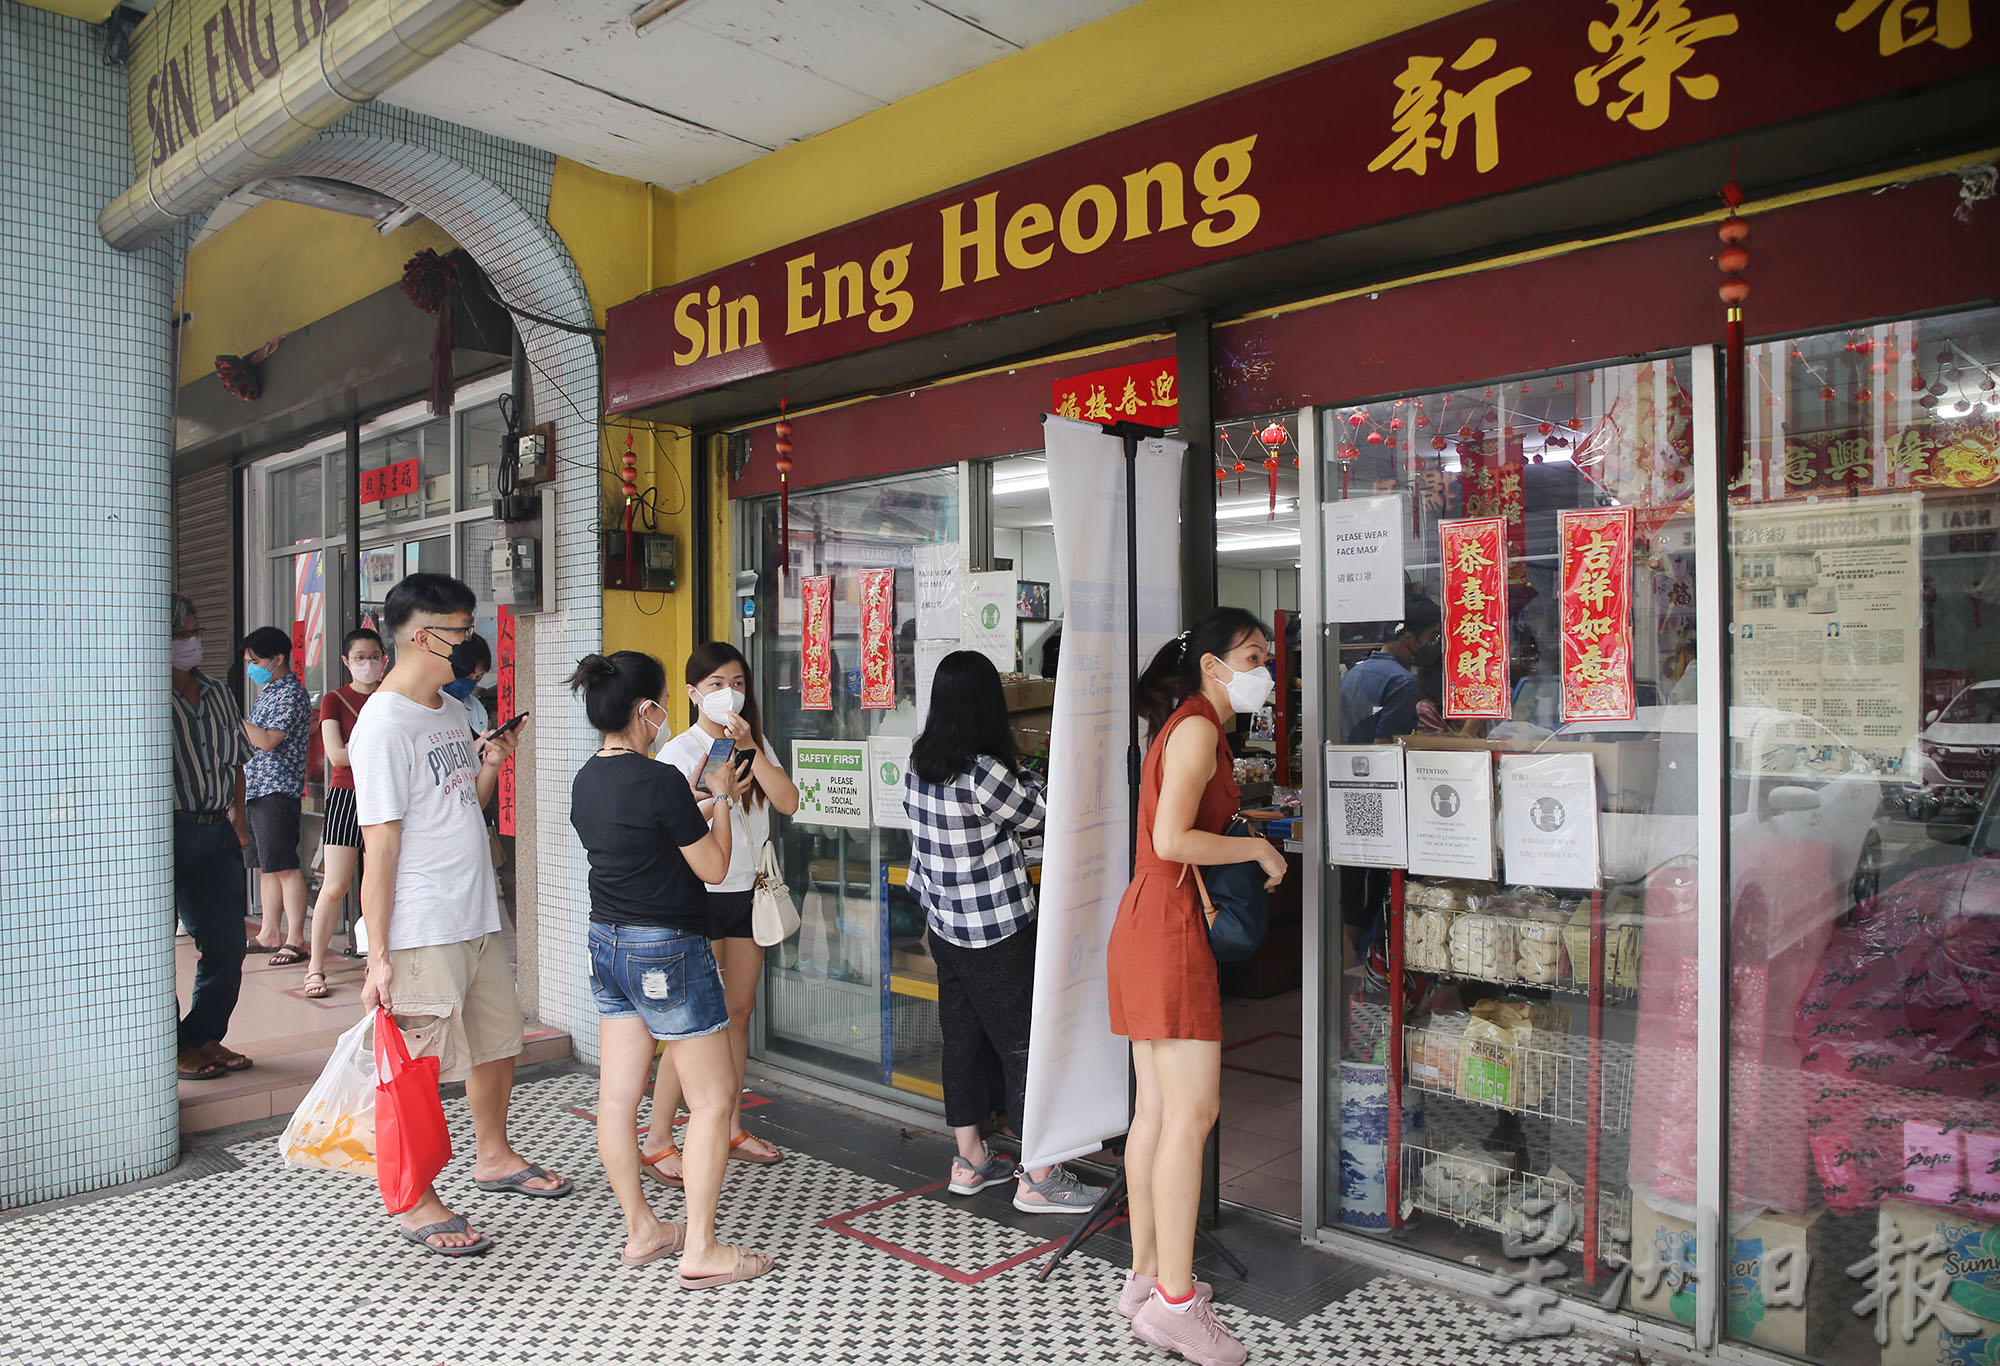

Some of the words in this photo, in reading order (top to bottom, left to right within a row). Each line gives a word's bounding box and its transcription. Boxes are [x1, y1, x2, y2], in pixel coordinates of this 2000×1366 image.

[147, 42, 199, 168] SIN
[204, 0, 280, 122] ENG
[672, 284, 760, 367] Sin
[784, 241, 915, 334] Eng
[939, 133, 1262, 294] Heong
[1336, 532, 1362, 542] PLEASE
[1364, 530, 1388, 540] WEAR
[1336, 547, 1355, 556] FACE
[1356, 545, 1379, 555] MASK
[1453, 539, 1495, 683] 恭喜發財
[1570, 531, 1618, 683] 吉祥如意
[804, 591, 825, 686] 吉祥如意
[864, 584, 886, 683] 恭喜發財
[428, 731, 444, 745] EST
[799, 753, 831, 764] SAFETY
[833, 754, 860, 765] FIRST
[1416, 767, 1449, 775] ATTENTION
[830, 776, 853, 785] PLEASE
[827, 786, 857, 796] MAINTAIN
[831, 796, 853, 806] SOCIAL
[825, 805, 861, 816] DISTANCING
